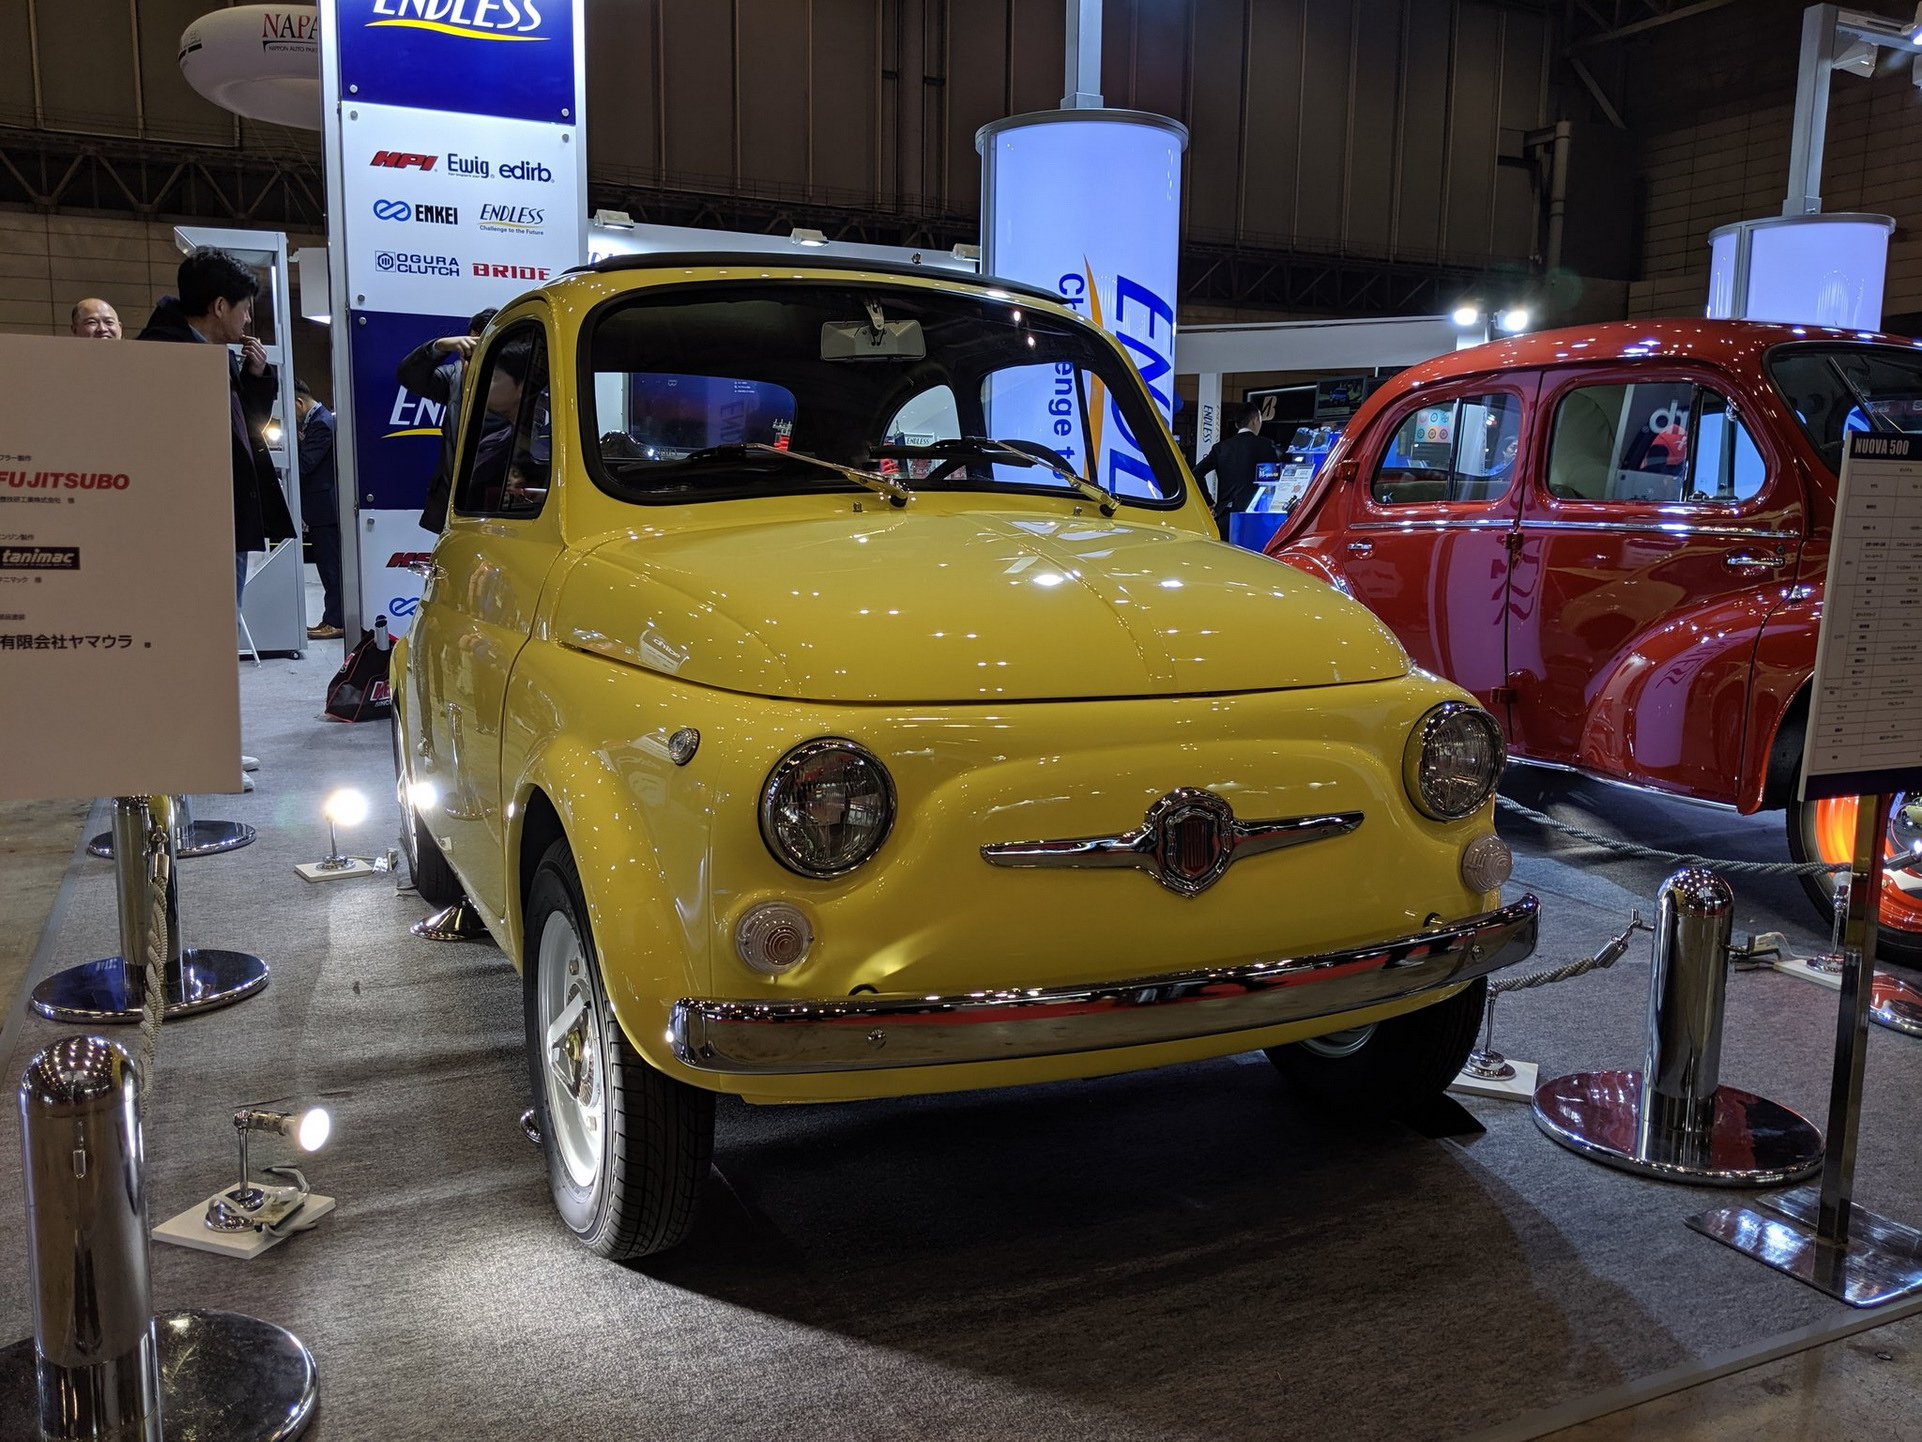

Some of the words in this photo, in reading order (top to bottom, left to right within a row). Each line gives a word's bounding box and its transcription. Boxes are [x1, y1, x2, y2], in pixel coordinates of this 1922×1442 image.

[370, 150, 439, 172] HPI
[447, 153, 490, 179] Ewig
[499, 161, 552, 183] edirb
[415, 204, 459, 226] ENKEI
[479, 203, 545, 225] ENDLESS
[480, 225, 508, 234] Challenge
[397, 253, 460, 267] OGURA
[397, 264, 460, 277] CLUTCH
[471, 262, 552, 281] BRIDE
[1203, 404, 1214, 444] ENDLESS
[1854, 438, 1888, 455] NUOVA
[1889, 439, 1910, 456] 500
[2, 548, 75, 563] tanimac
[0, 634, 133, 650] 有限会社ヤマウラ
